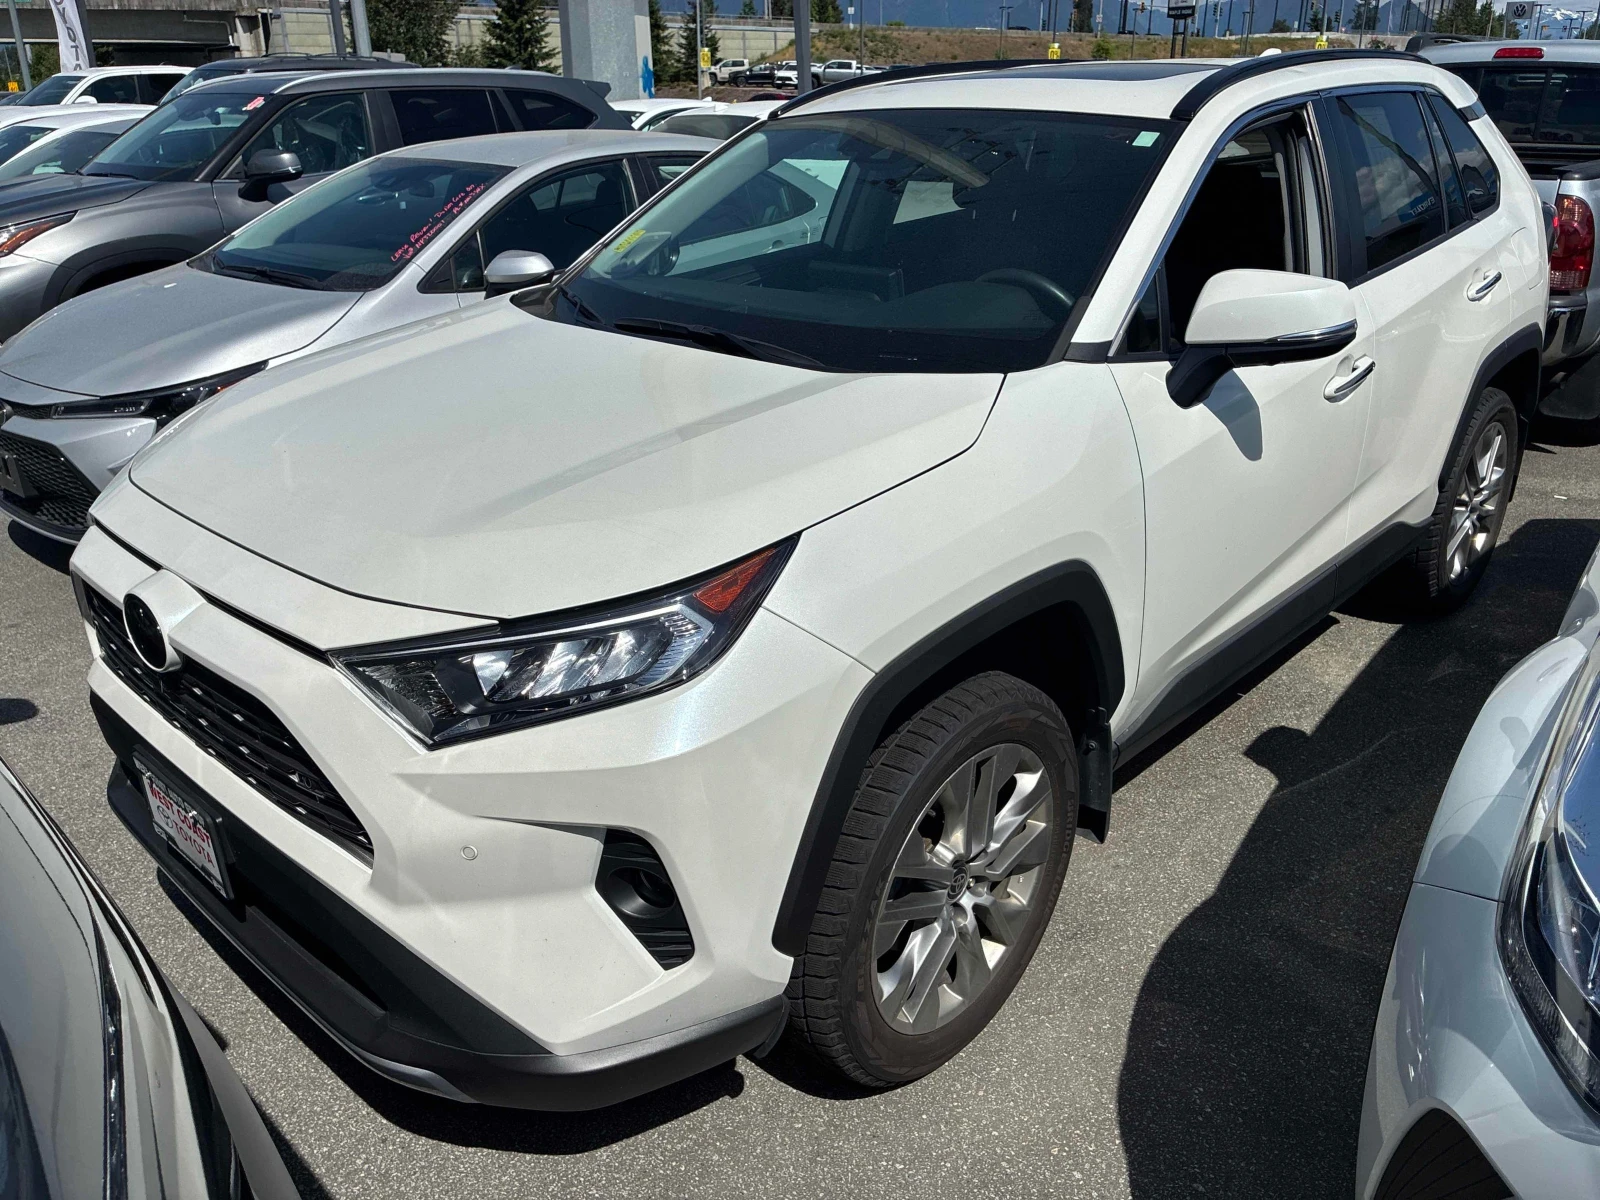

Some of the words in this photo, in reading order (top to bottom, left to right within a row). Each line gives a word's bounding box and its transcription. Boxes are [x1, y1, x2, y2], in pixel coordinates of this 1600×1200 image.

[149, 785, 175, 815] WEST
[176, 809, 212, 848] COAST
[173, 820, 215, 868] TOYOTA
